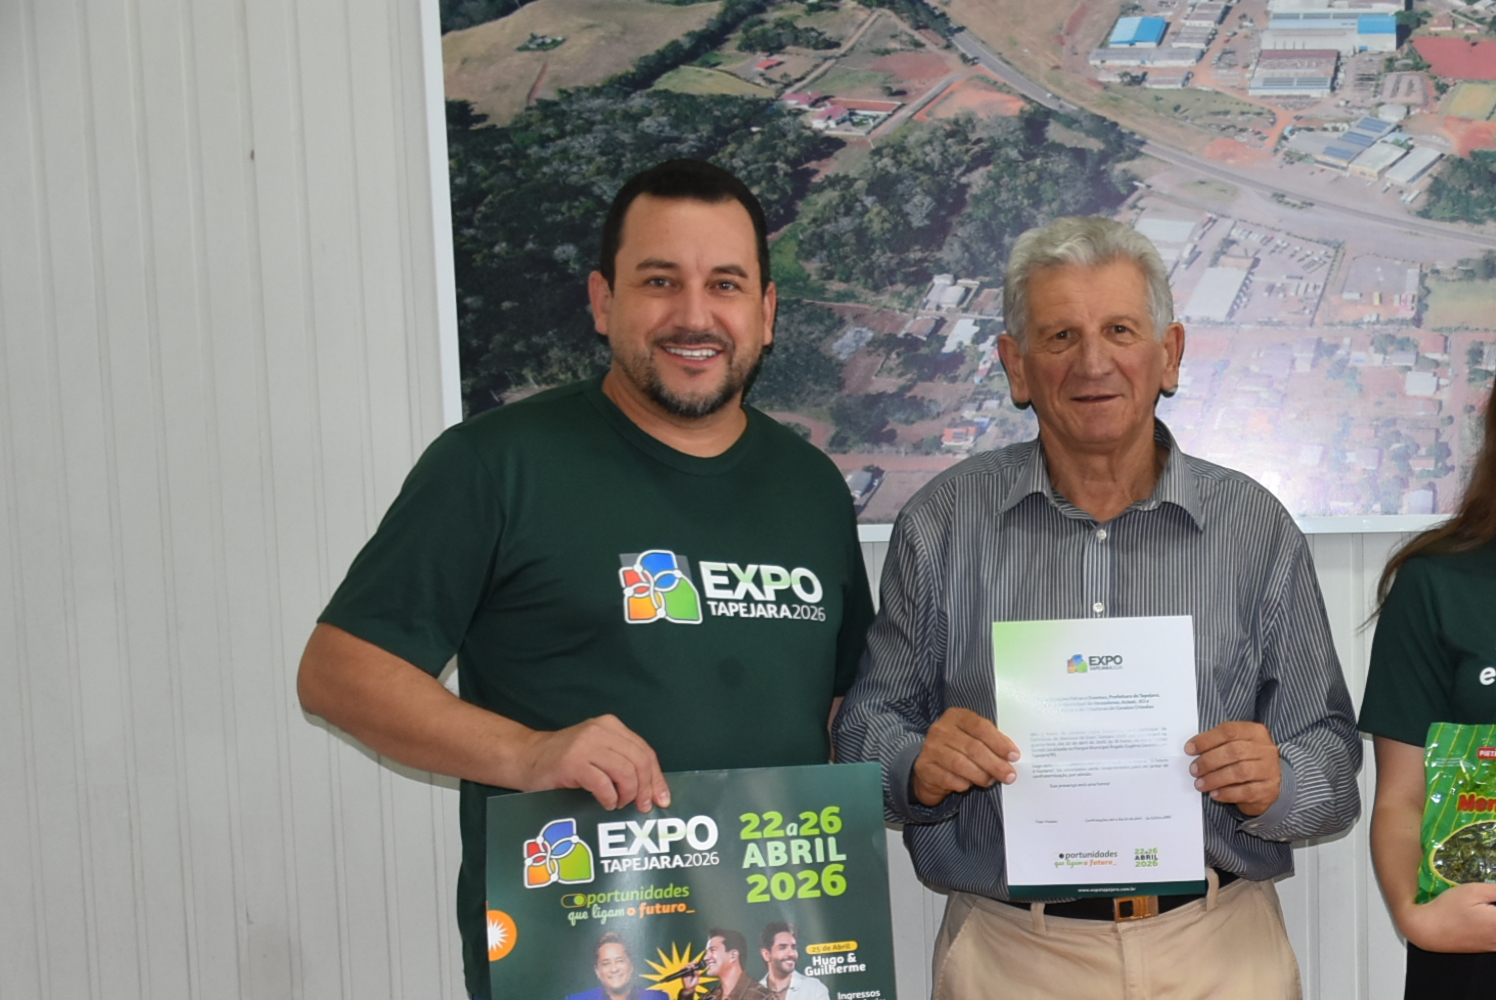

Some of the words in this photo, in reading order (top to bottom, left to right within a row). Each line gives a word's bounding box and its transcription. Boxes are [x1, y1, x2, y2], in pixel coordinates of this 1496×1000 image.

[699, 561, 823, 603] EXPO
[1089, 655, 1123, 666] EXPO
[598, 815, 719, 857] EXPO
[742, 836, 847, 869] ABRIL
[746, 863, 847, 903] 2026
[568, 909, 588, 926] que
[592, 904, 624, 924] ligam
[627, 907, 636, 916] o
[823, 944, 830, 952] de
[832, 942, 850, 951] Abril
[812, 955, 844, 967] Hugo
[847, 953, 857, 963] &
[805, 963, 866, 976] Guilherme
[837, 990, 880, 1000] Ingressos
